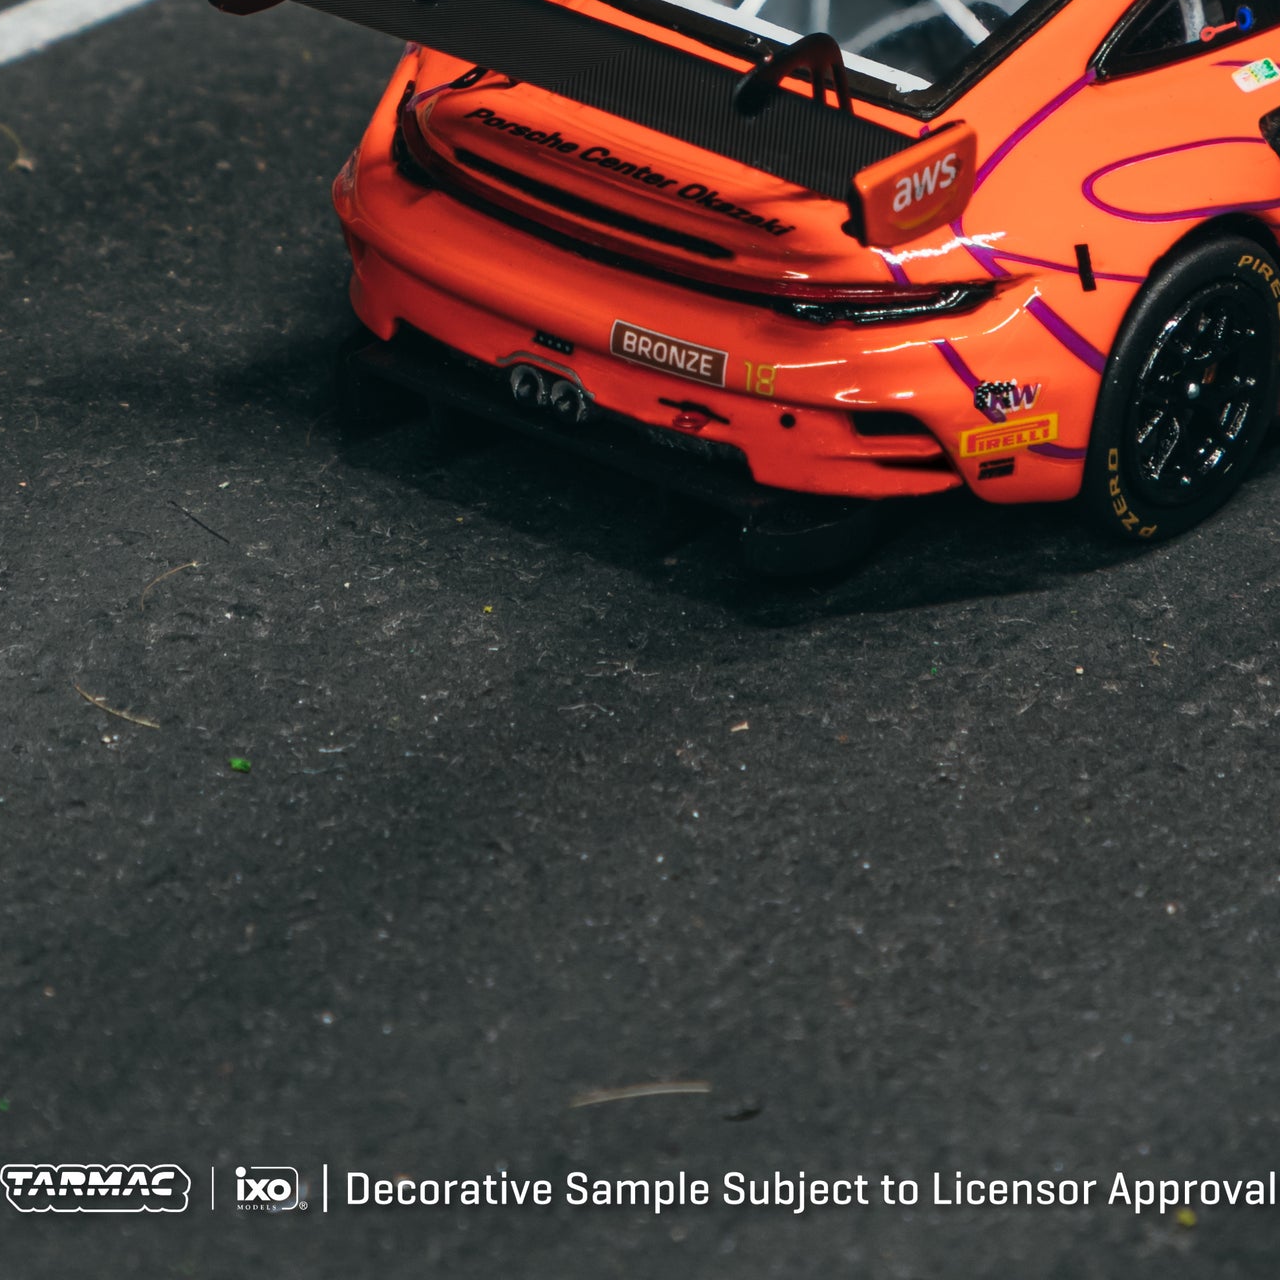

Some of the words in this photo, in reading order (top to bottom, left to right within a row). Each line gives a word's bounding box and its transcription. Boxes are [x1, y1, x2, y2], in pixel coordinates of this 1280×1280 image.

[464, 107, 580, 154] Porsche
[579, 146, 678, 189] Center
[677, 183, 797, 238] Okazaki
[892, 152, 957, 213] aws
[622, 330, 714, 377] BRONZE
[744, 361, 777, 397] 18
[966, 419, 1051, 454] PIRELLI
